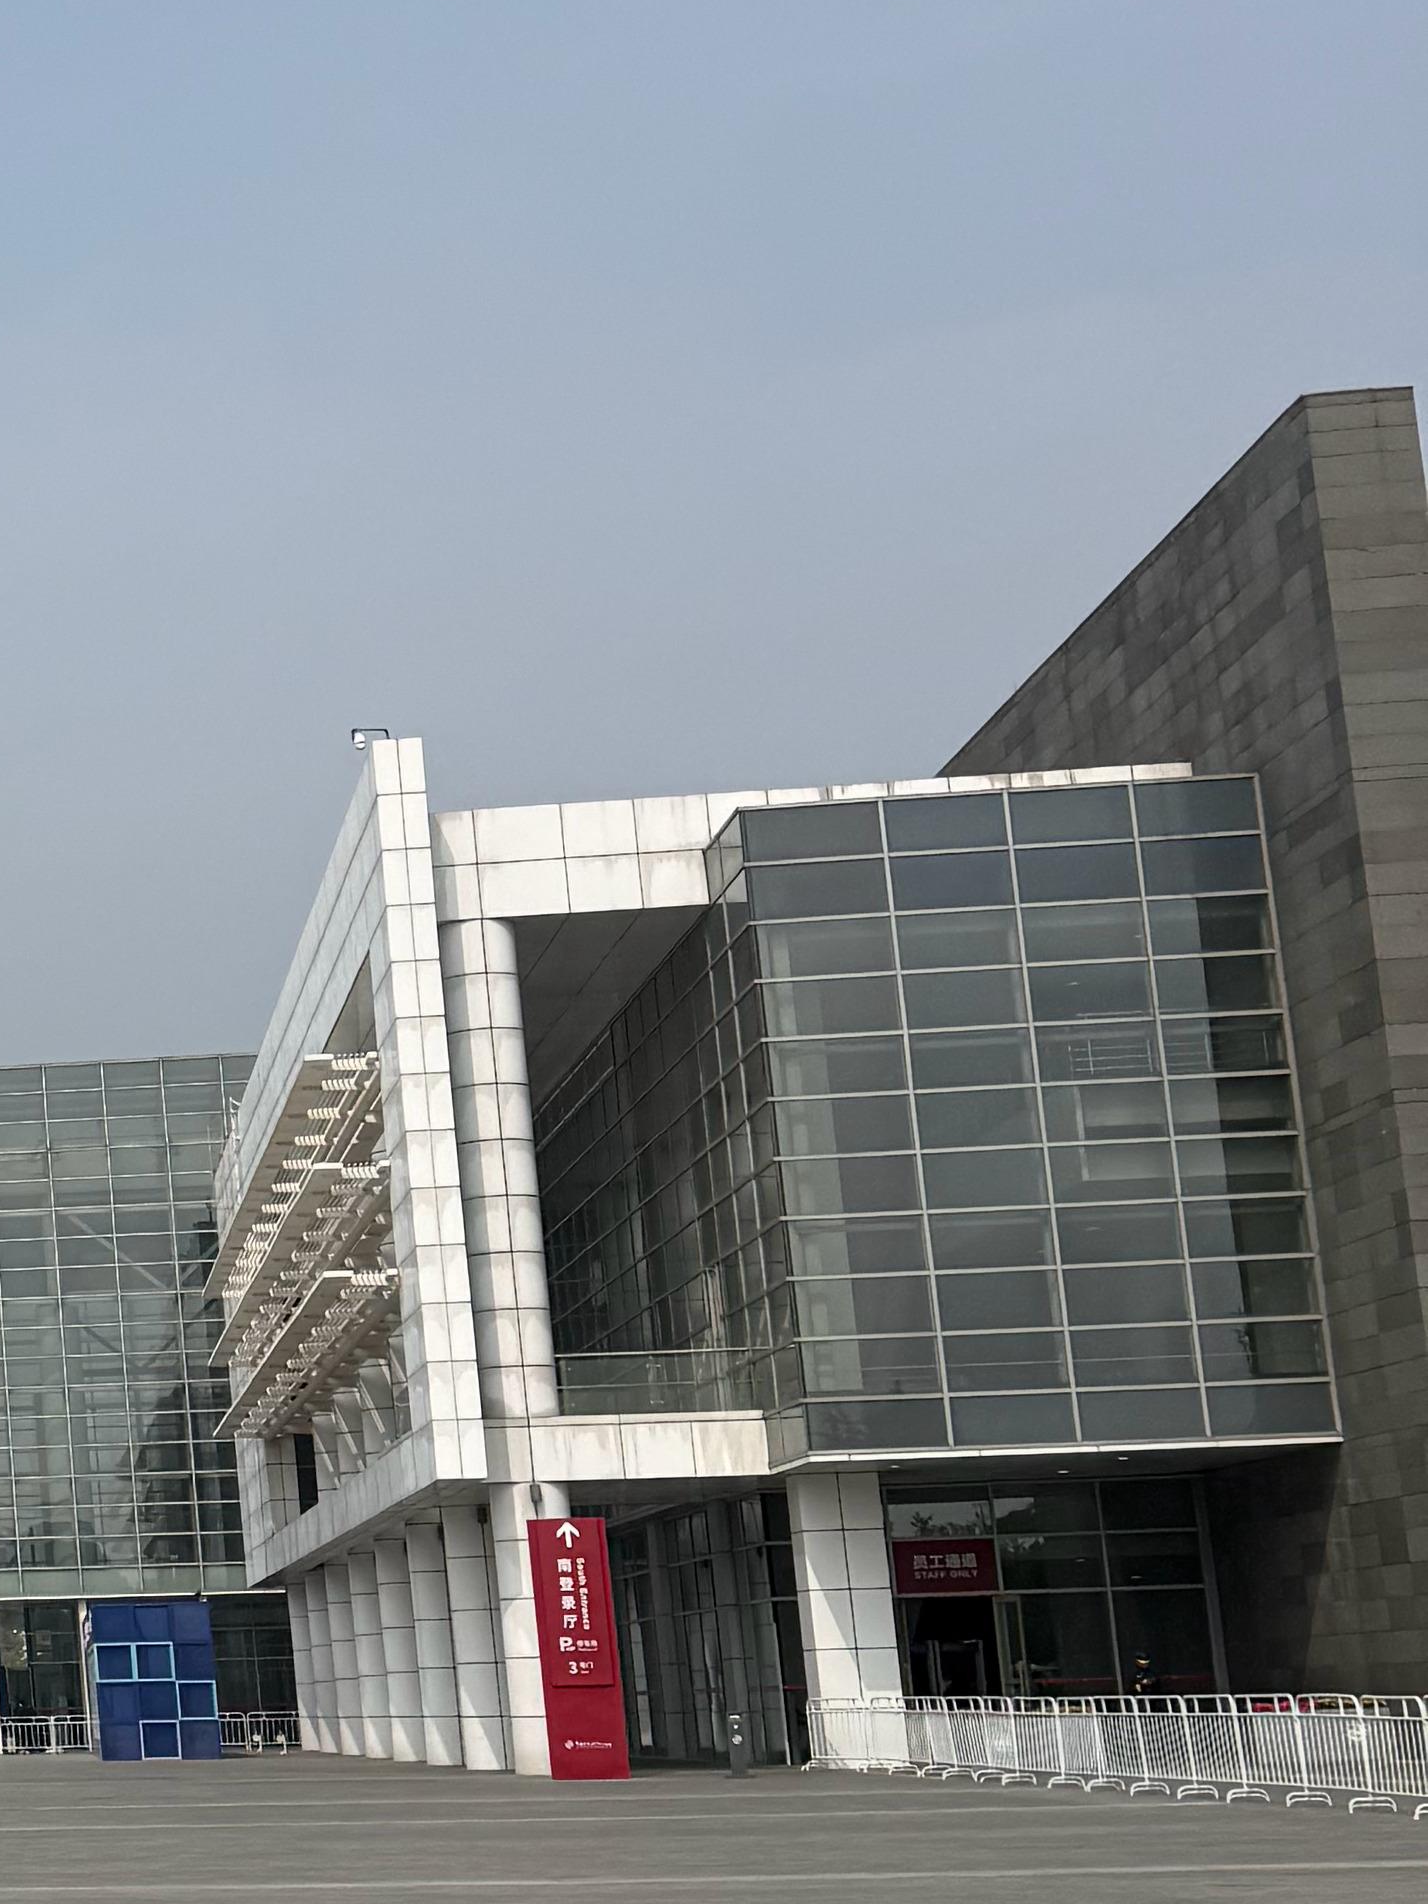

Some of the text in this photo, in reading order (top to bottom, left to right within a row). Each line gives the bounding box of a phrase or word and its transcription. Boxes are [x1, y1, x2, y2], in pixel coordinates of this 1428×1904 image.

[556, 1558, 578, 1629] 南登录厅
[914, 1569, 978, 1580] STAFF ONLY
